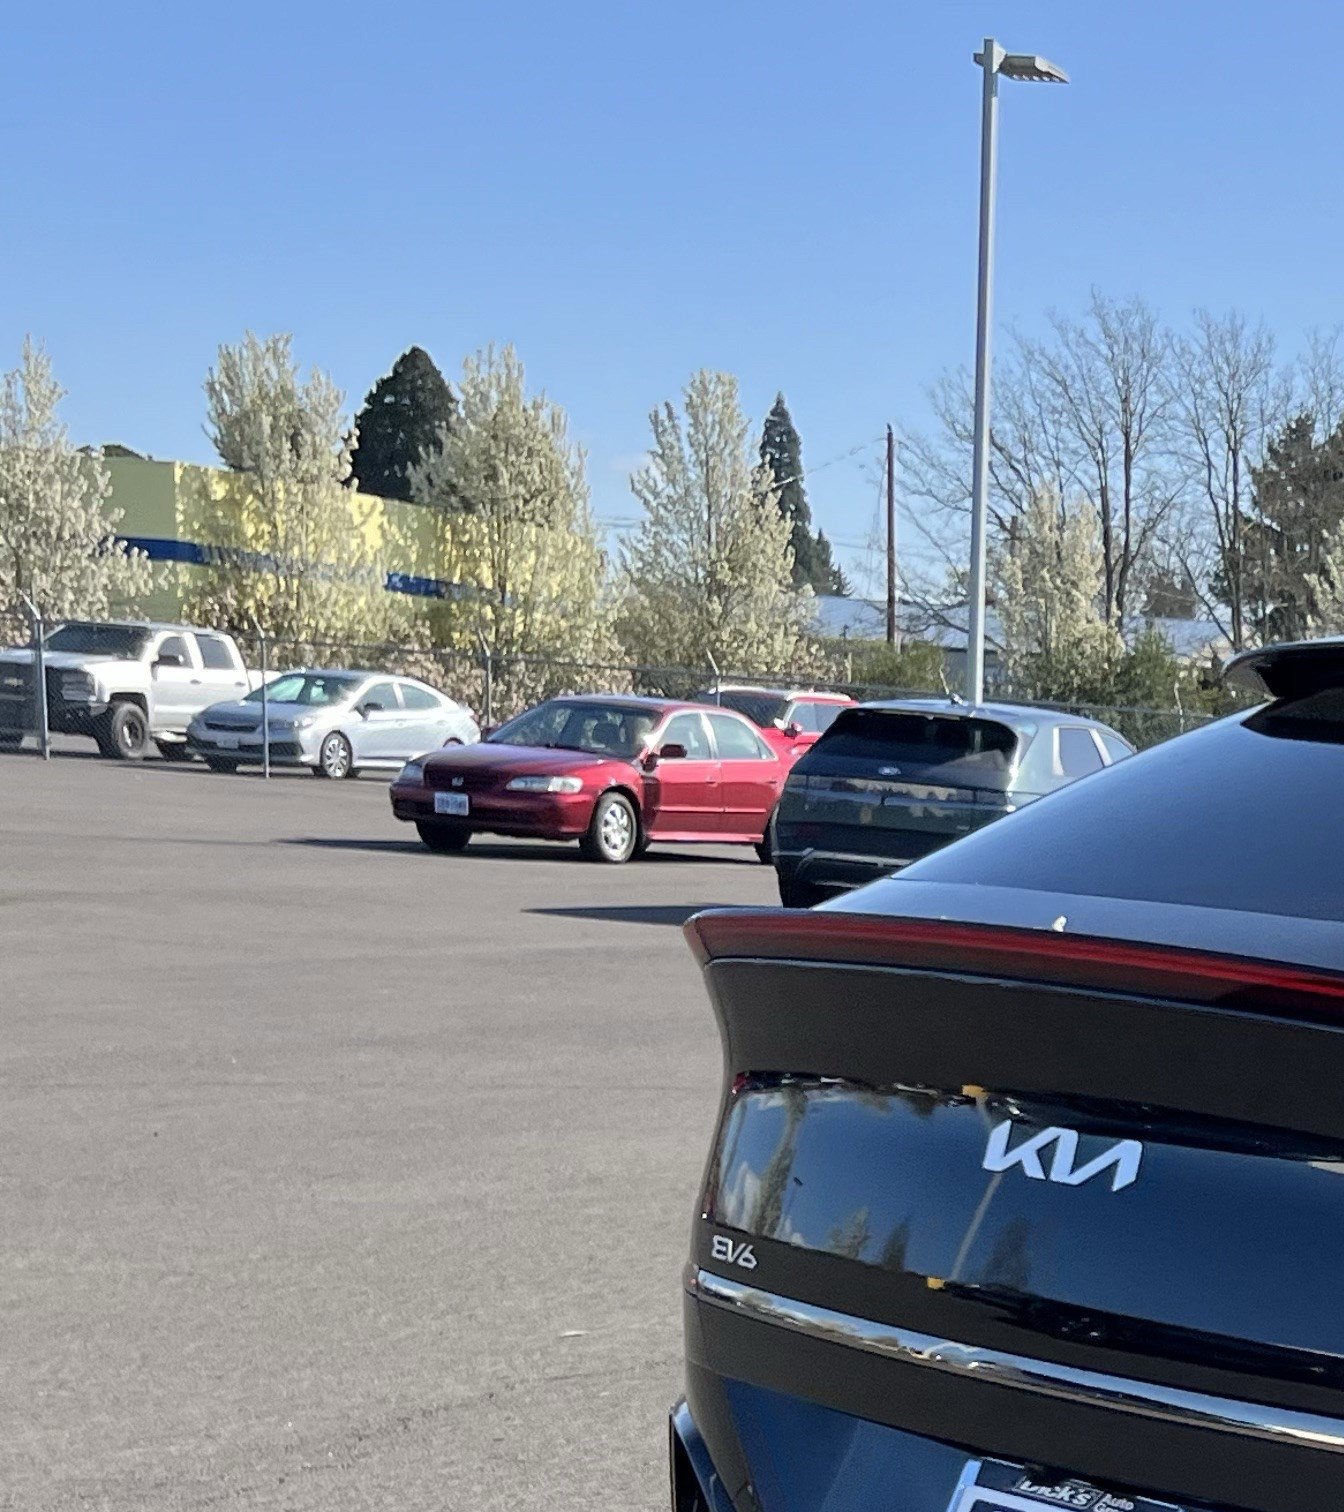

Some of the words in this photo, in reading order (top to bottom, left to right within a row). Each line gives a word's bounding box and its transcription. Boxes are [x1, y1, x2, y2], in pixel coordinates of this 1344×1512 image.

[982, 1119, 1144, 1192] KIA
[712, 1235, 758, 1269] EV6
[1100, 1493, 1135, 1511] Auto
